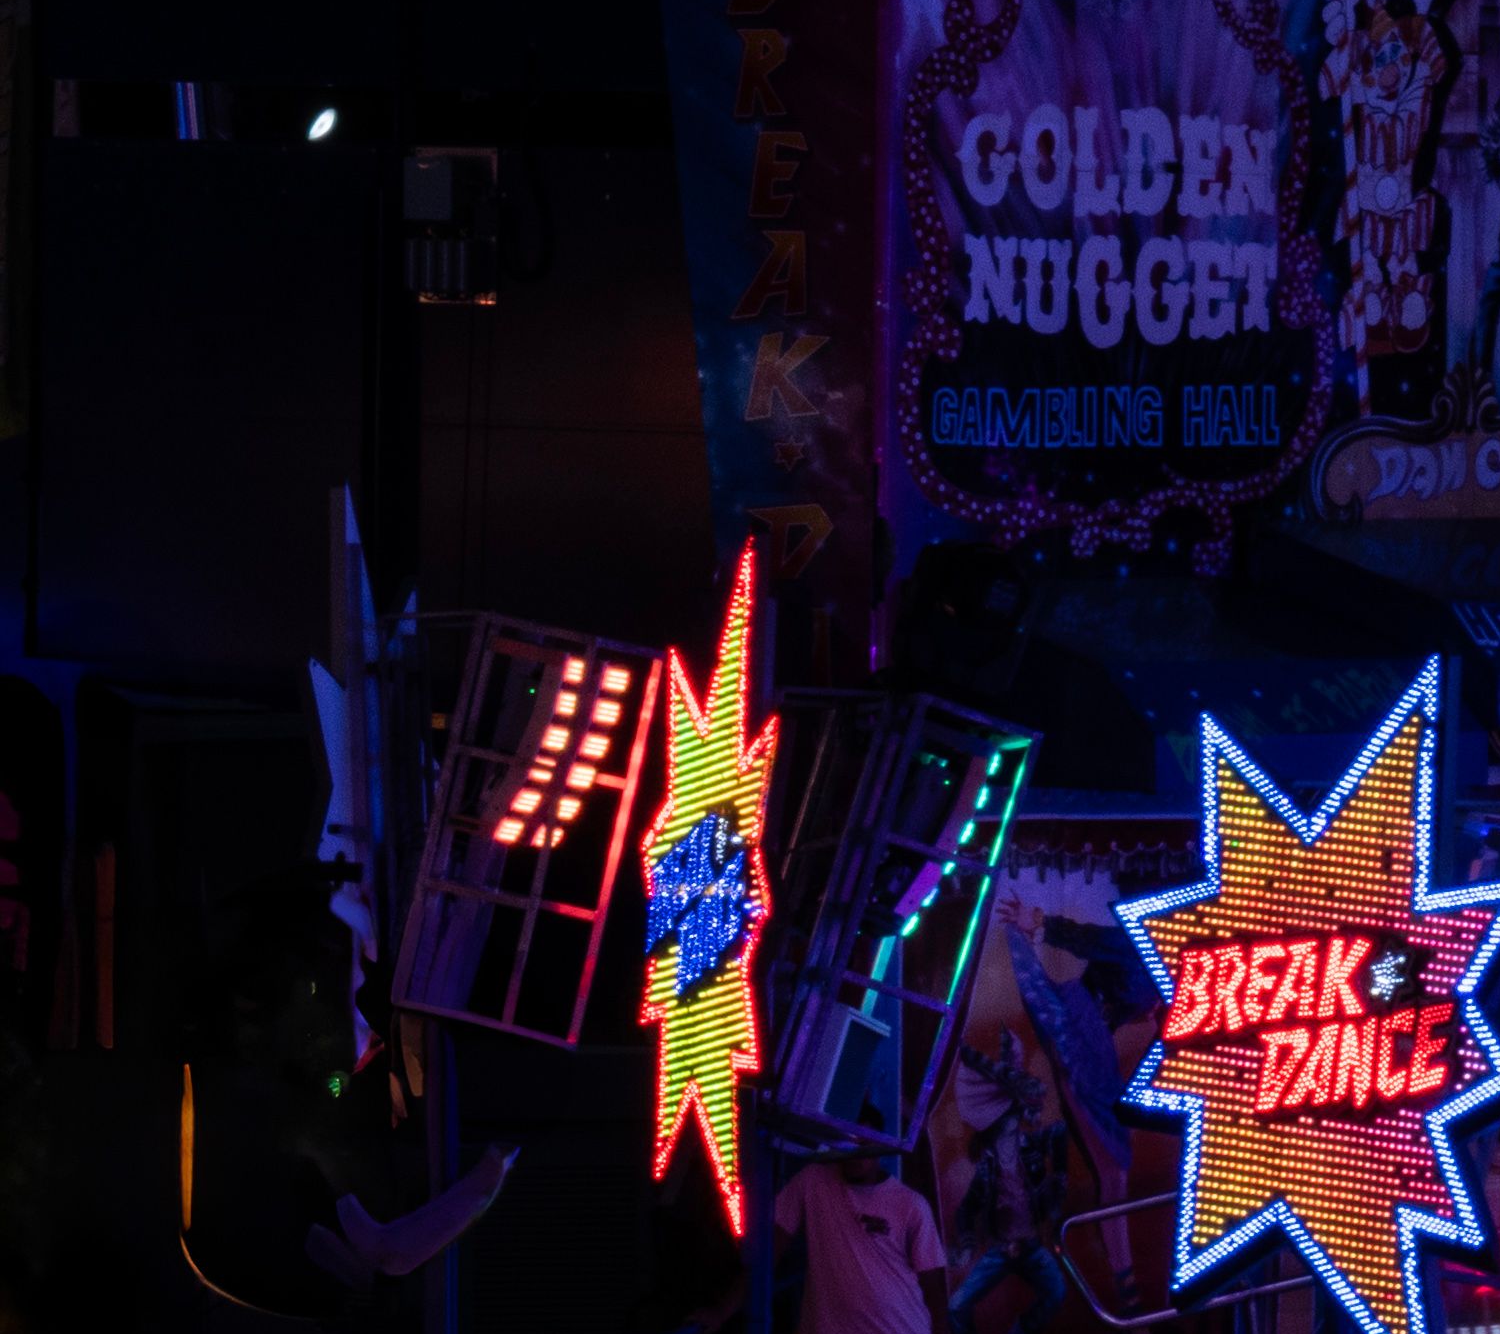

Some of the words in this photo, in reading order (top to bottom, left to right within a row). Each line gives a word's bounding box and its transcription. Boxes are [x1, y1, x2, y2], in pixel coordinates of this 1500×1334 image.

[955, 103, 1279, 220] GOLDEN
[962, 233, 1279, 350] NUGGET
[931, 385, 1165, 450] GAMBLING
[1180, 384, 1282, 448] HALL
[1162, 936, 1373, 1041] BREAK
[1254, 1001, 1456, 1114] DANCE
